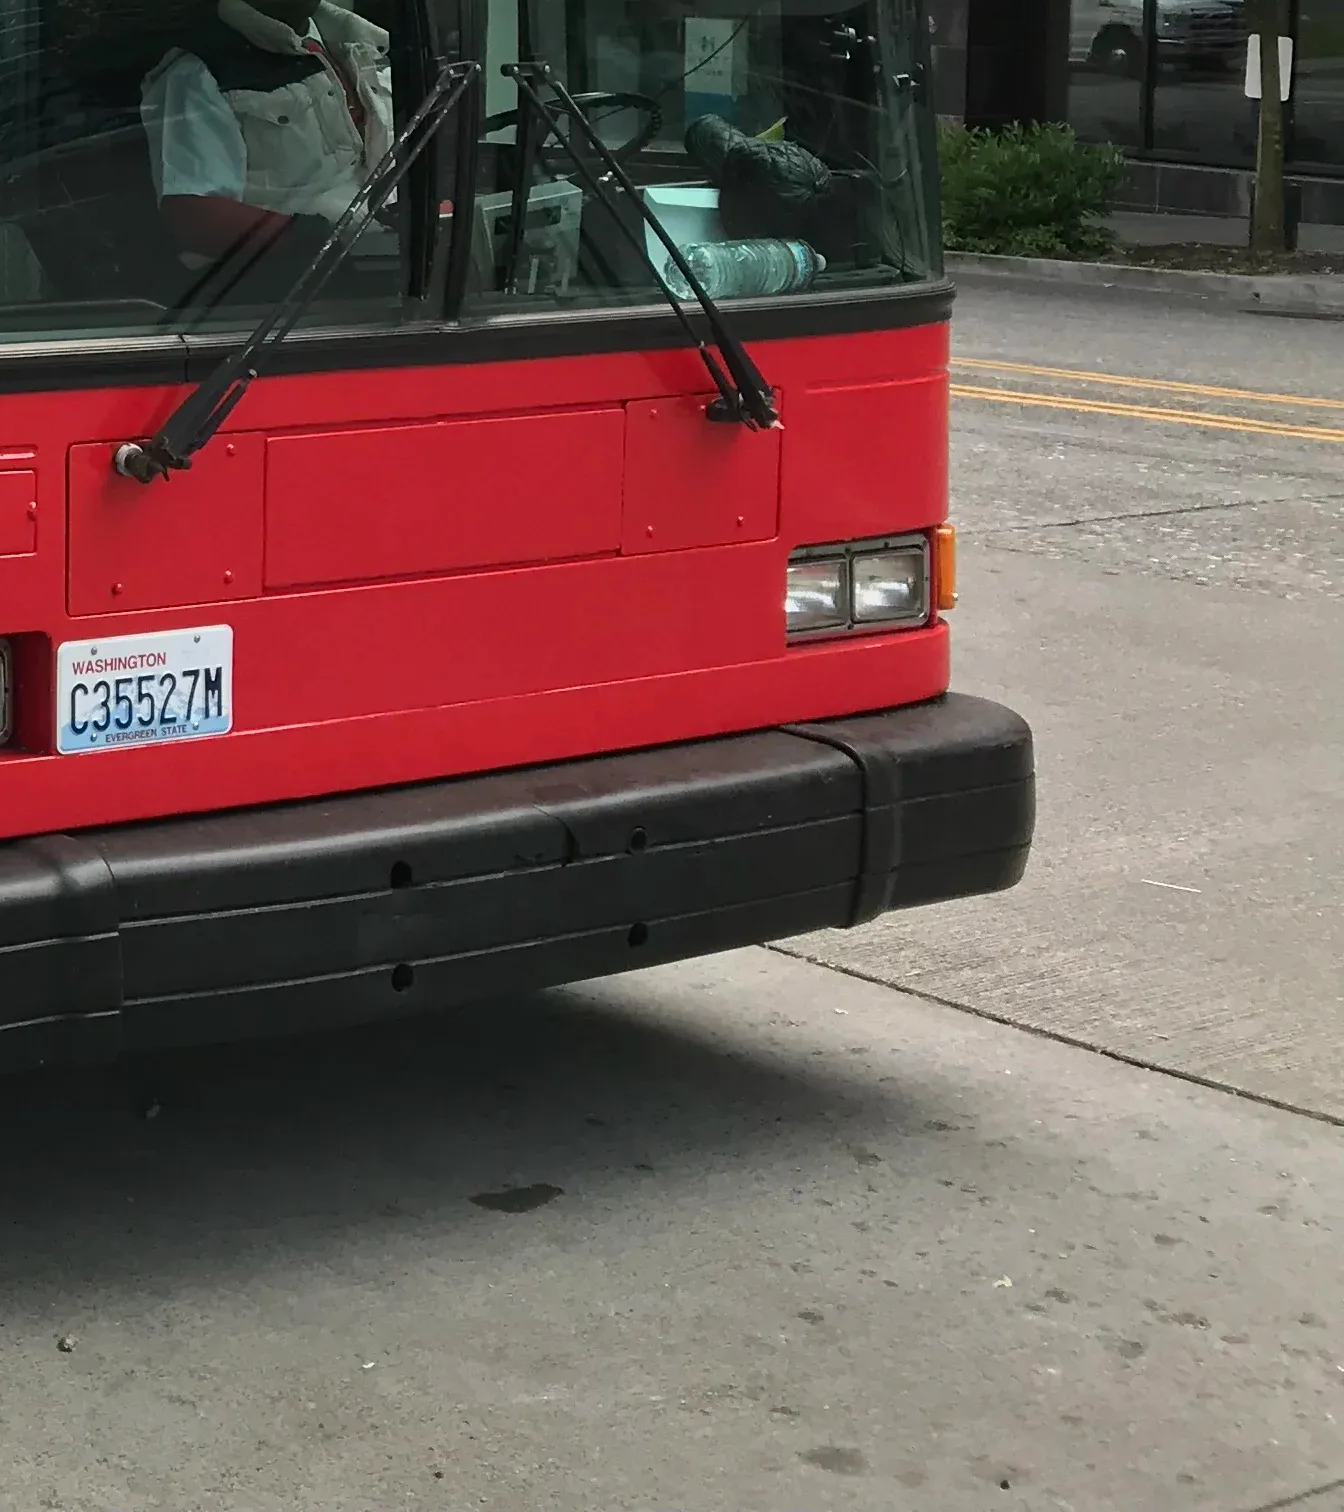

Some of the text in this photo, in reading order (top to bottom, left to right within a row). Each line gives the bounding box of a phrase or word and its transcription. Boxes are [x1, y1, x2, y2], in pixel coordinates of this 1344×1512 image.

[72, 652, 167, 675] WASHINGTON
[70, 666, 223, 735] C35527M
[105, 724, 187, 743] EVERGREEN STATE
